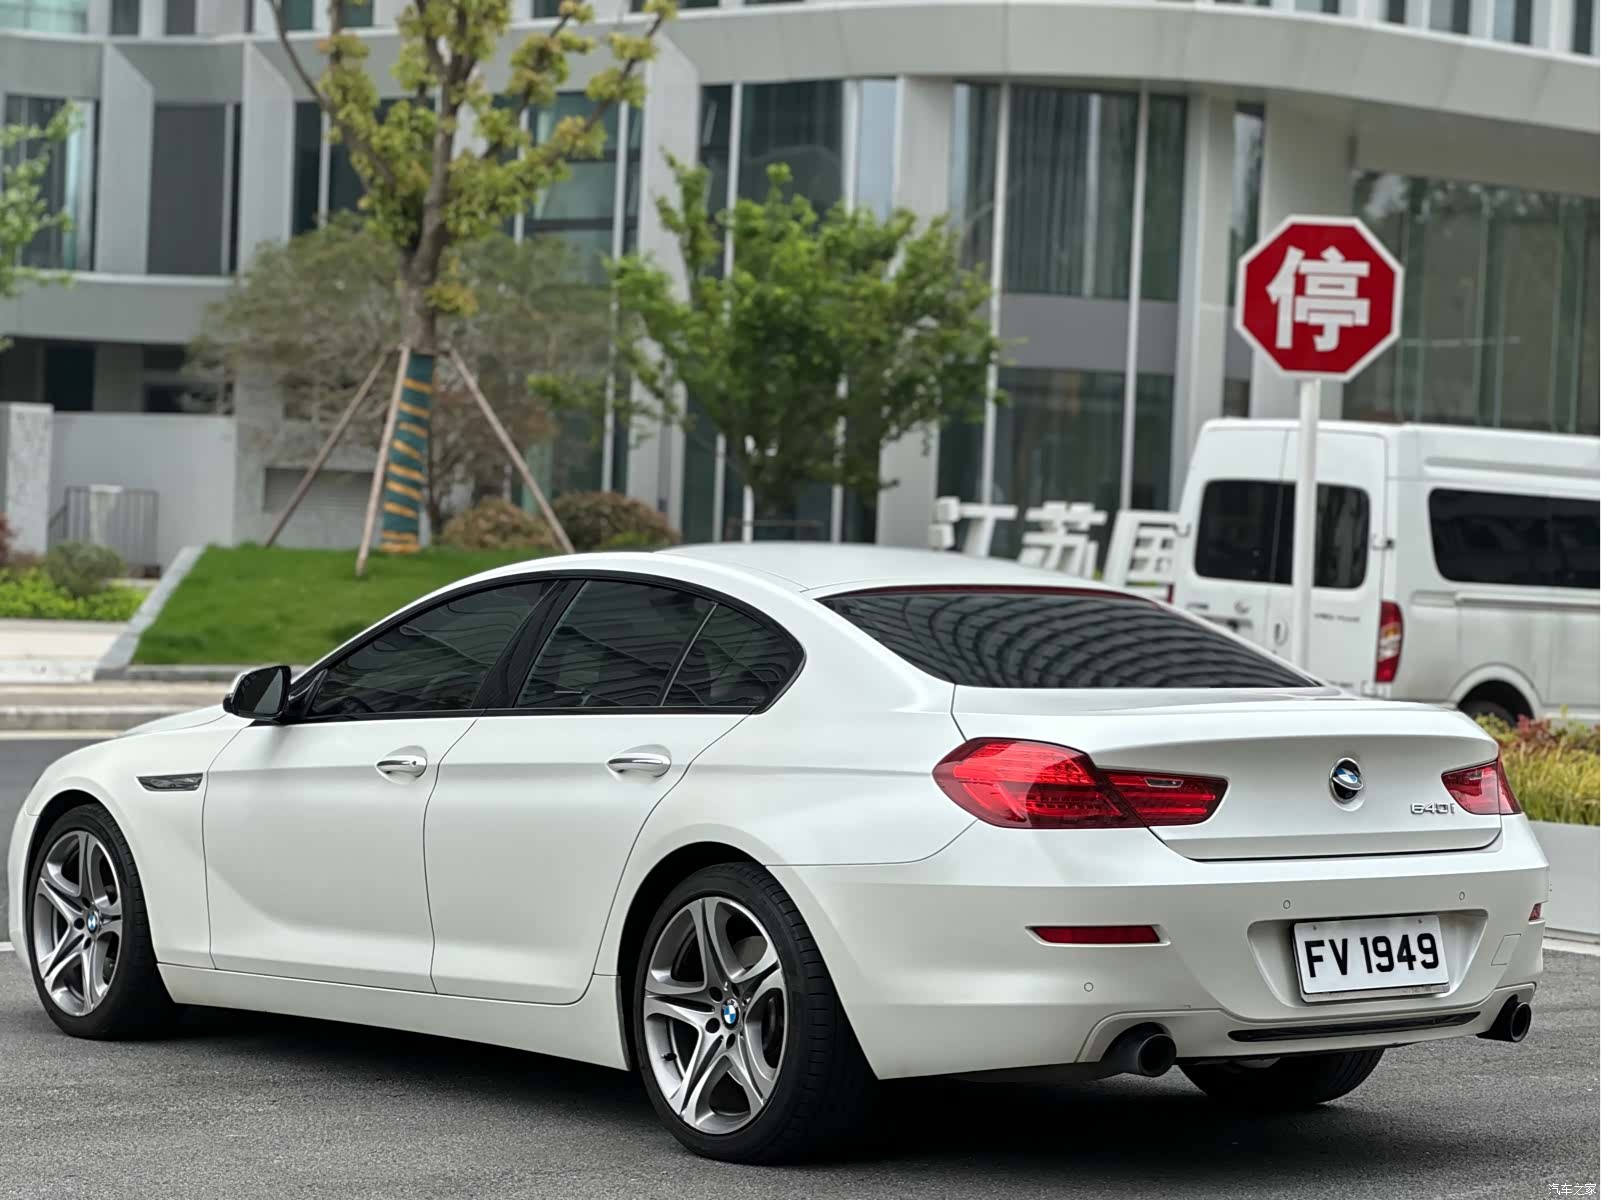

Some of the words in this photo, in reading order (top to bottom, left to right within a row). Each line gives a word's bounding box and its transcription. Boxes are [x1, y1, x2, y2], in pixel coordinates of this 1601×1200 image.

[1265, 245, 1370, 352] 停
[1410, 802, 1455, 815] 640i
[1304, 938, 1348, 978] FV
[1360, 933, 1439, 974] 1949
